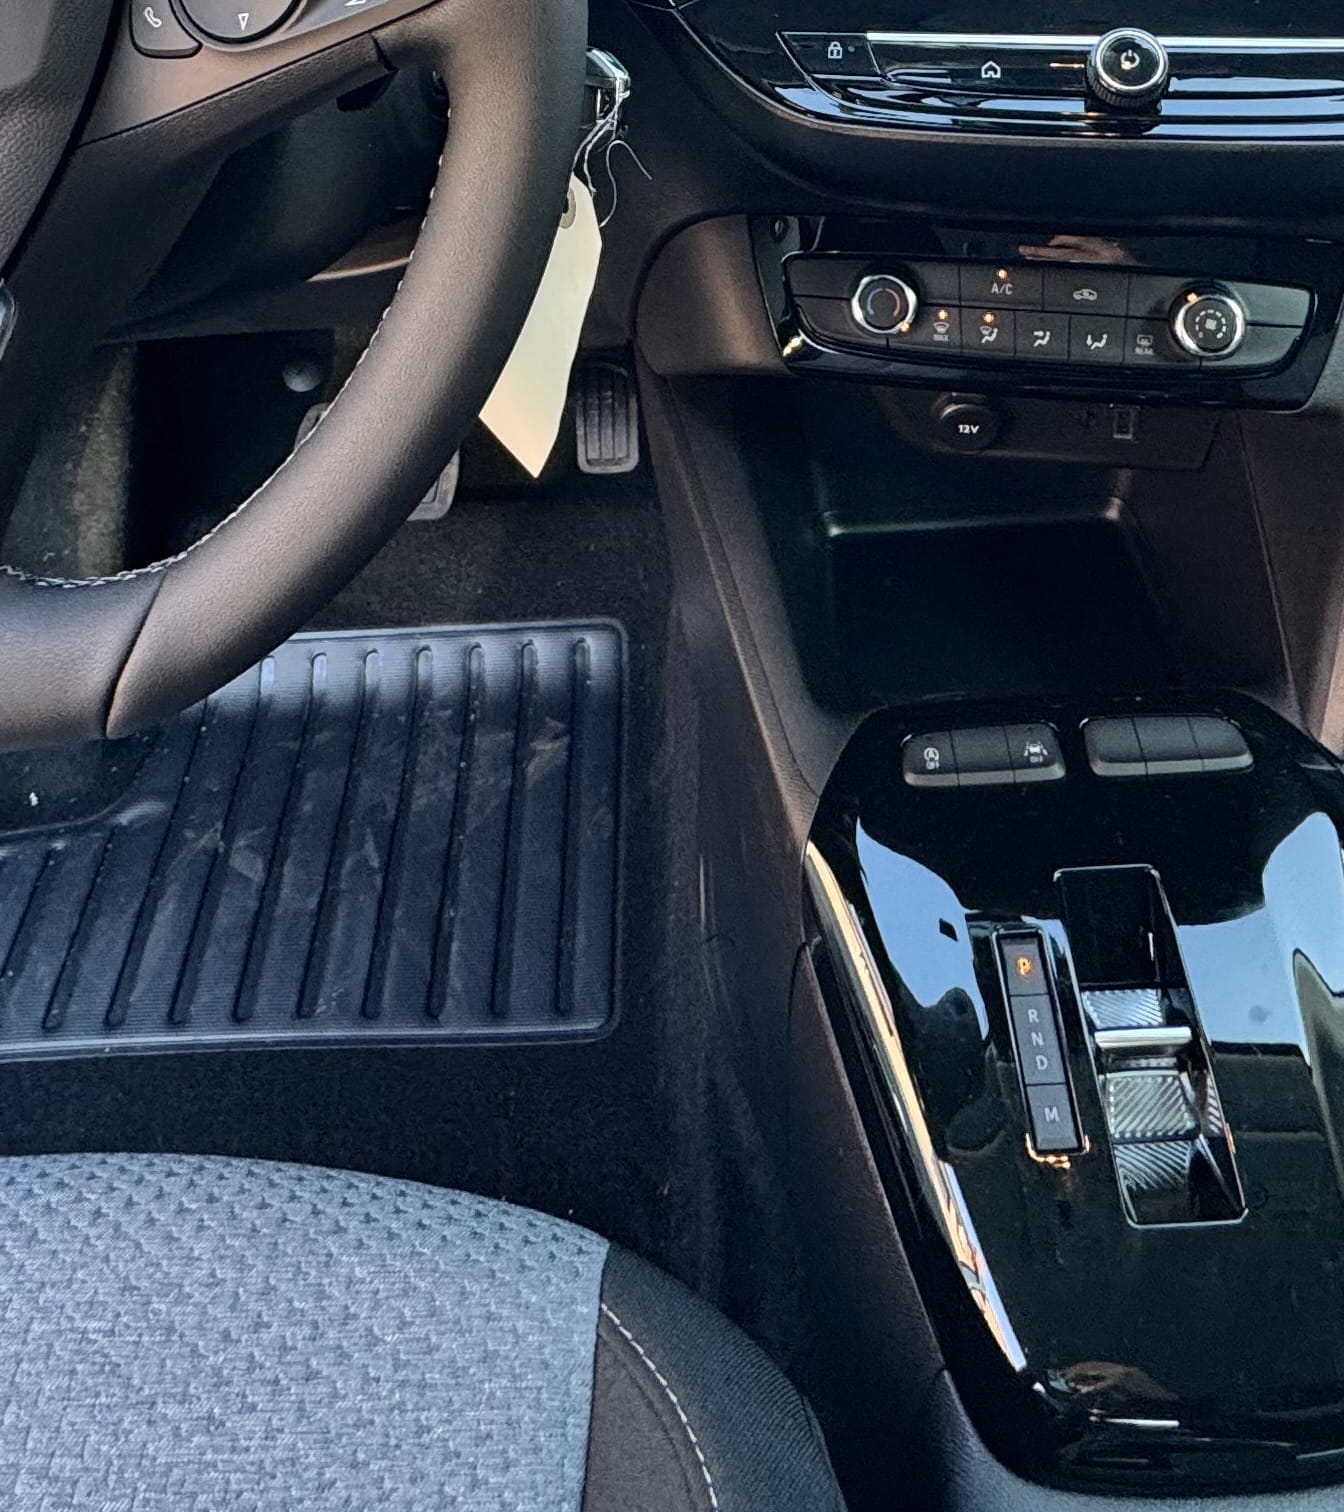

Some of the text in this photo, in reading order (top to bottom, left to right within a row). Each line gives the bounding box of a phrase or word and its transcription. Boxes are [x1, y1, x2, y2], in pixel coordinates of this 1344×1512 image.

[991, 282, 1013, 296] A/C
[958, 423, 980, 434] 12V
[1017, 957, 1032, 975] P
[1028, 1009, 1039, 1024] R
[1031, 1032, 1044, 1047] N
[1036, 1054, 1048, 1070] D
[1044, 1106, 1060, 1123] M
